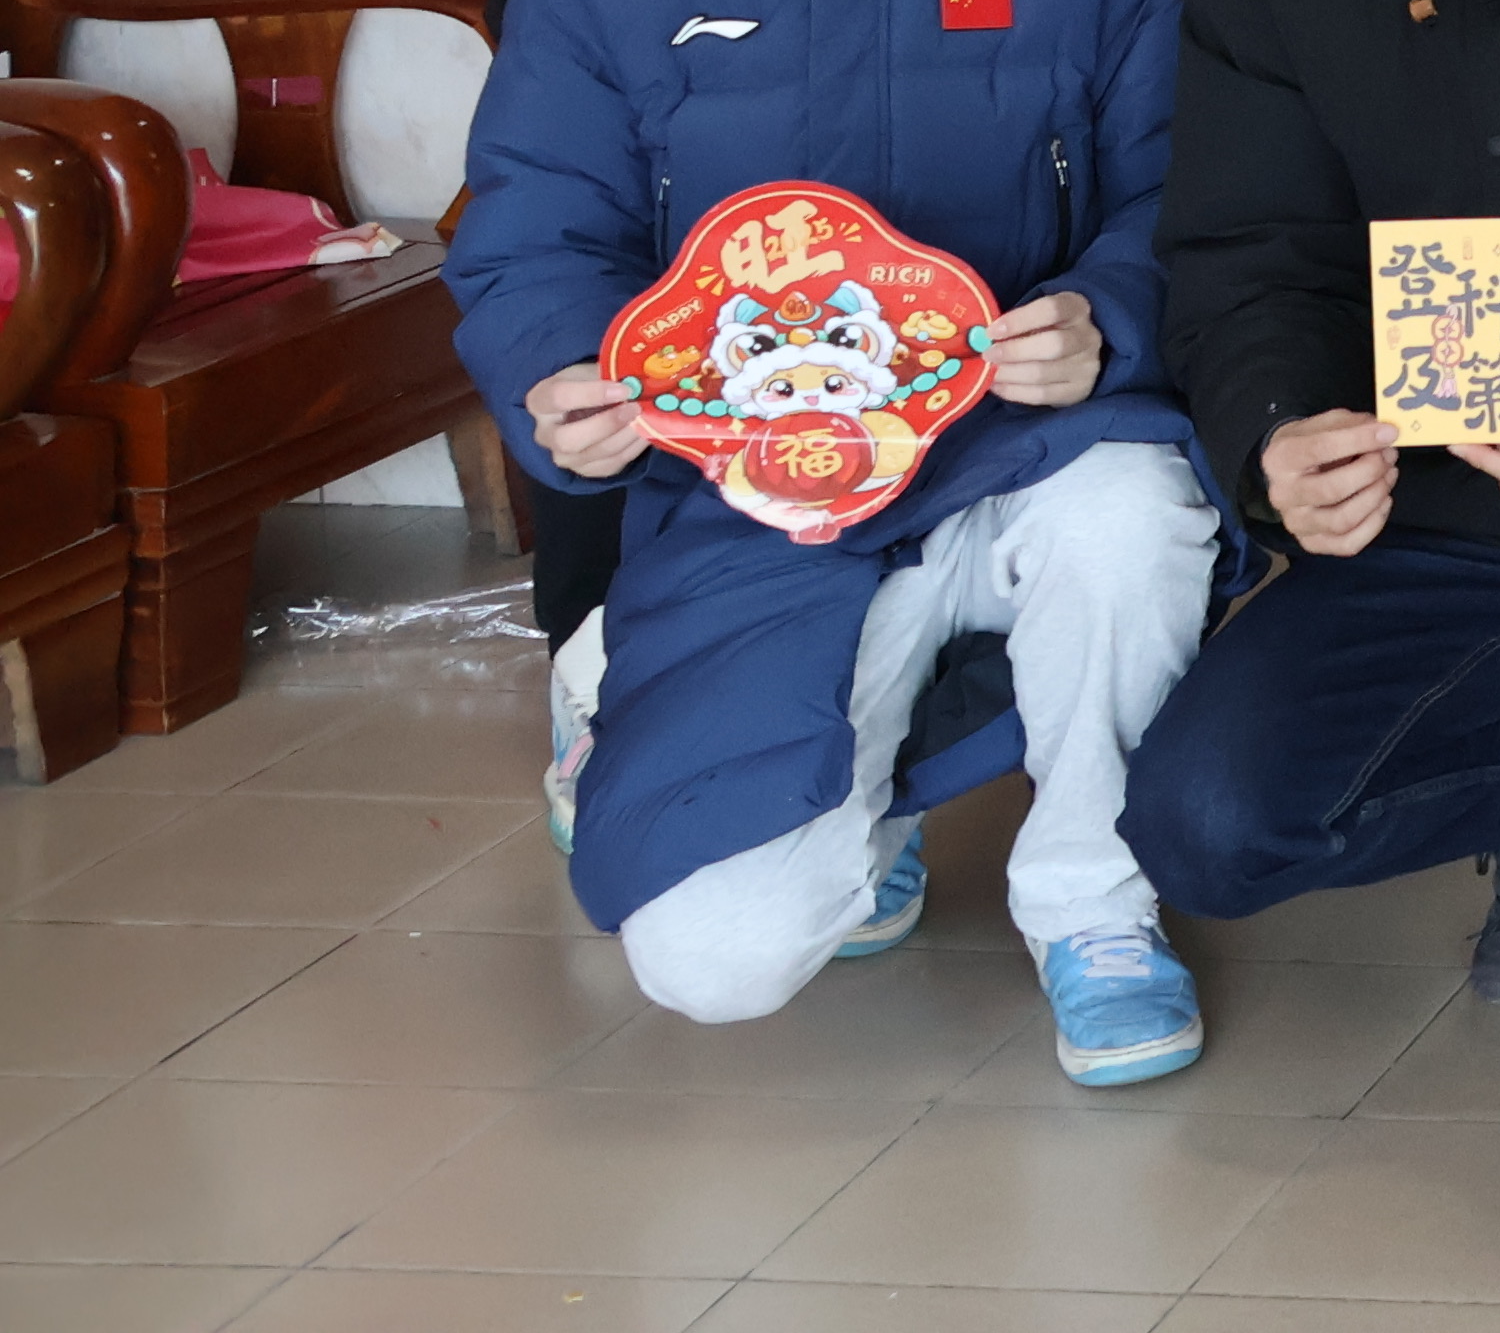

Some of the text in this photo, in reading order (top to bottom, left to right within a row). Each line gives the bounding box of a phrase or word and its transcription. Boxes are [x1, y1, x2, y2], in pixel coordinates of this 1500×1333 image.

[720, 199, 846, 294] 旺
[869, 266, 933, 284] RICH
[643, 298, 704, 340] HAPPY
[773, 428, 844, 480] 福
